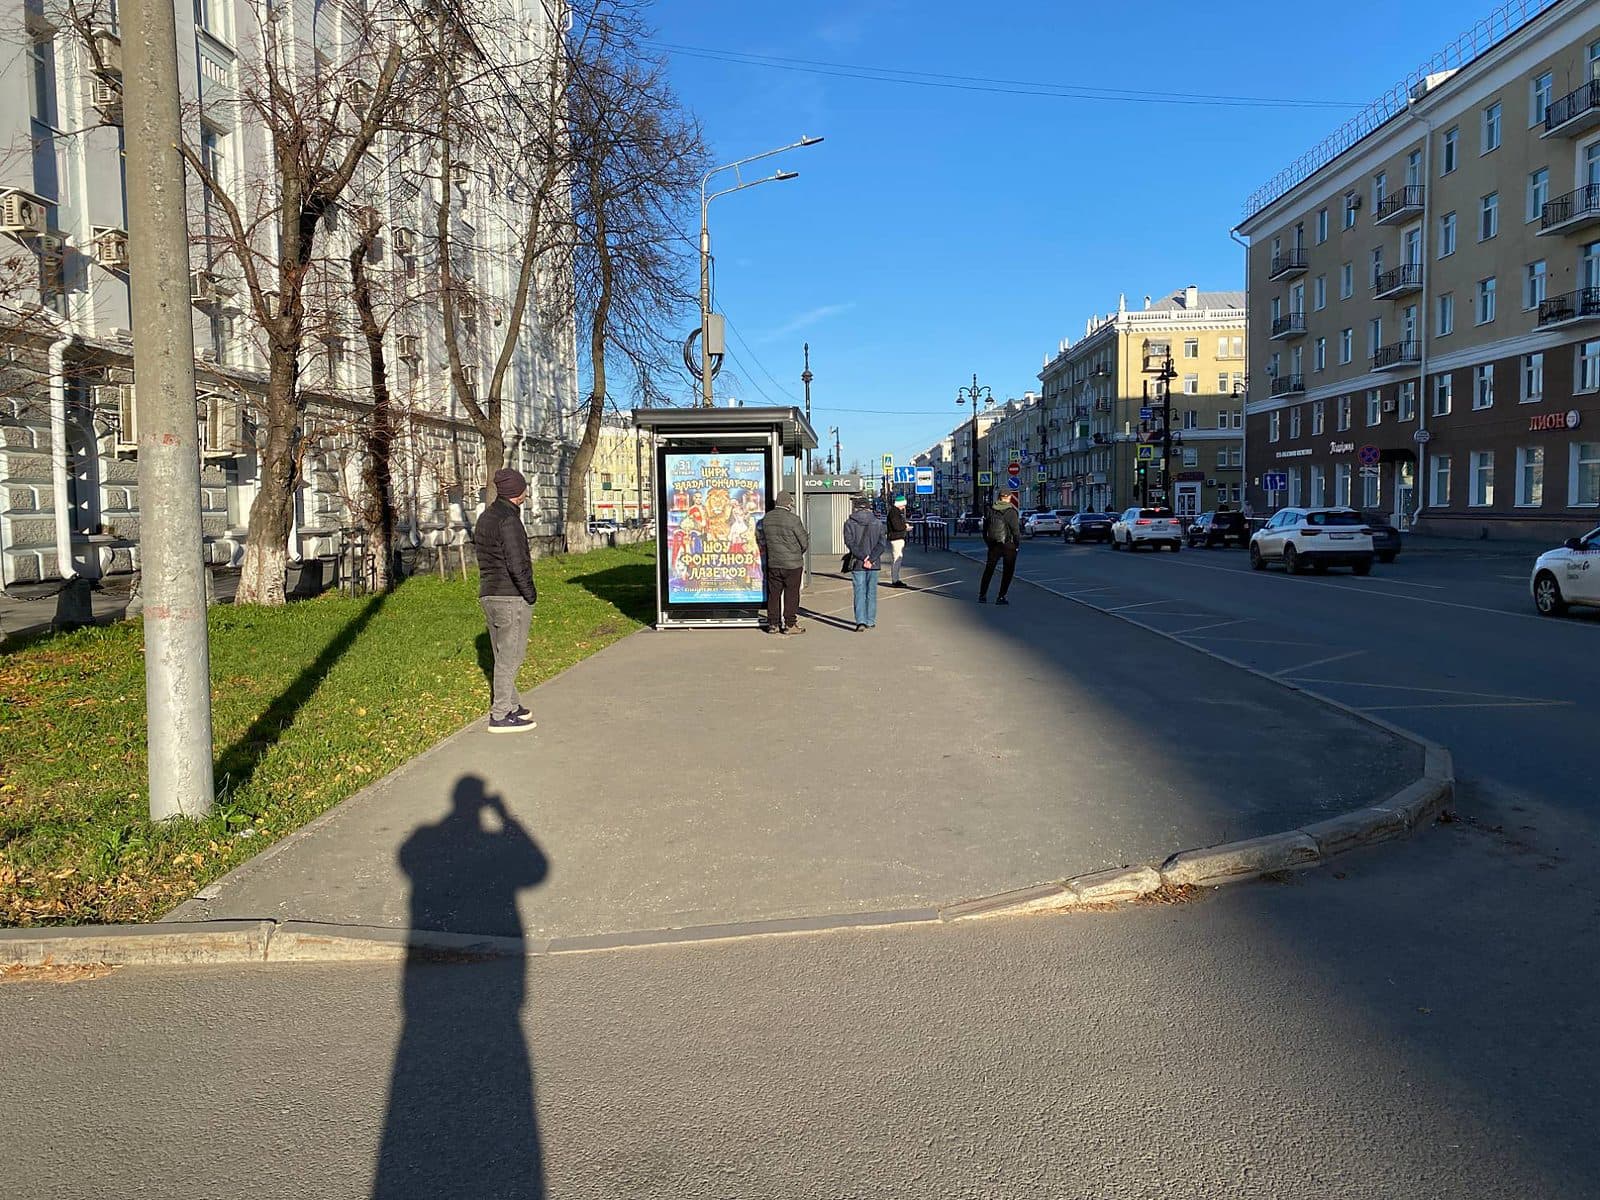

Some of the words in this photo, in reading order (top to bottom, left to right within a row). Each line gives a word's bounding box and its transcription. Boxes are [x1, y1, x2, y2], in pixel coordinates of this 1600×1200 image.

[1529, 412, 1566, 431] ЛИОН
[701, 467, 729, 477] ЦИРК
[703, 541, 730, 553] ШОУ
[681, 553, 754, 566] ФОНТАНОВ
[689, 567, 747, 580] ЛАЗЕРОВ
